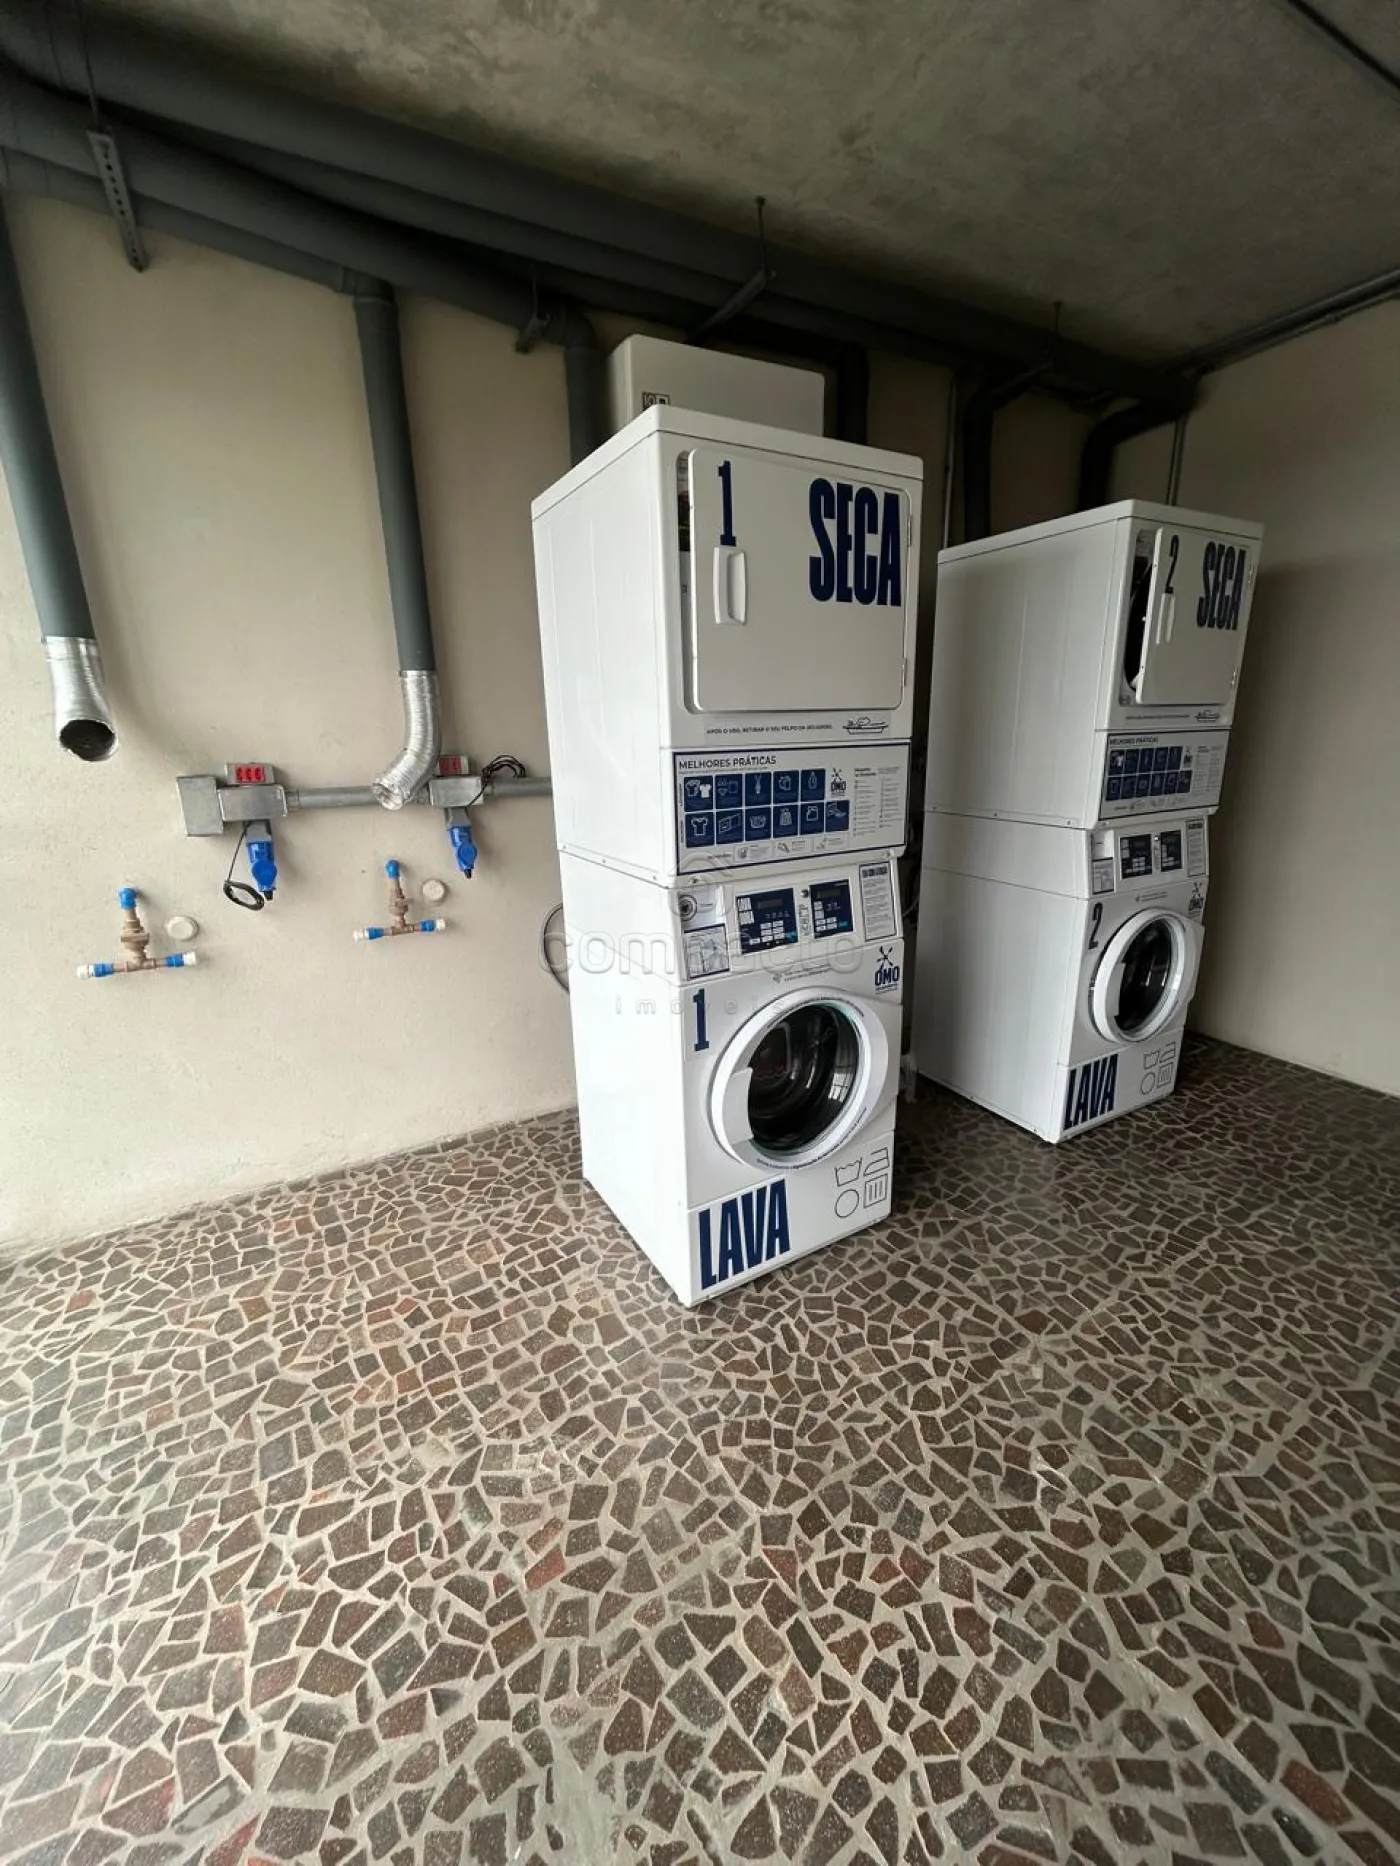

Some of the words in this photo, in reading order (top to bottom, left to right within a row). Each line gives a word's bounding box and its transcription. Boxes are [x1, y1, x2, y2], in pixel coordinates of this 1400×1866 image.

[717, 460, 736, 548] 1
[809, 477, 902, 607] SECA
[1164, 534, 1180, 594] 2
[1196, 541, 1247, 631] SECA
[679, 758, 732, 769] MELHORES
[733, 754, 777, 765] PRÁTICAS
[1088, 902, 1103, 950] 2
[874, 965, 900, 986] OMO
[693, 987, 709, 1051] 1
[1063, 1053, 1119, 1131] LAVA
[698, 1178, 790, 1291] LAVA
